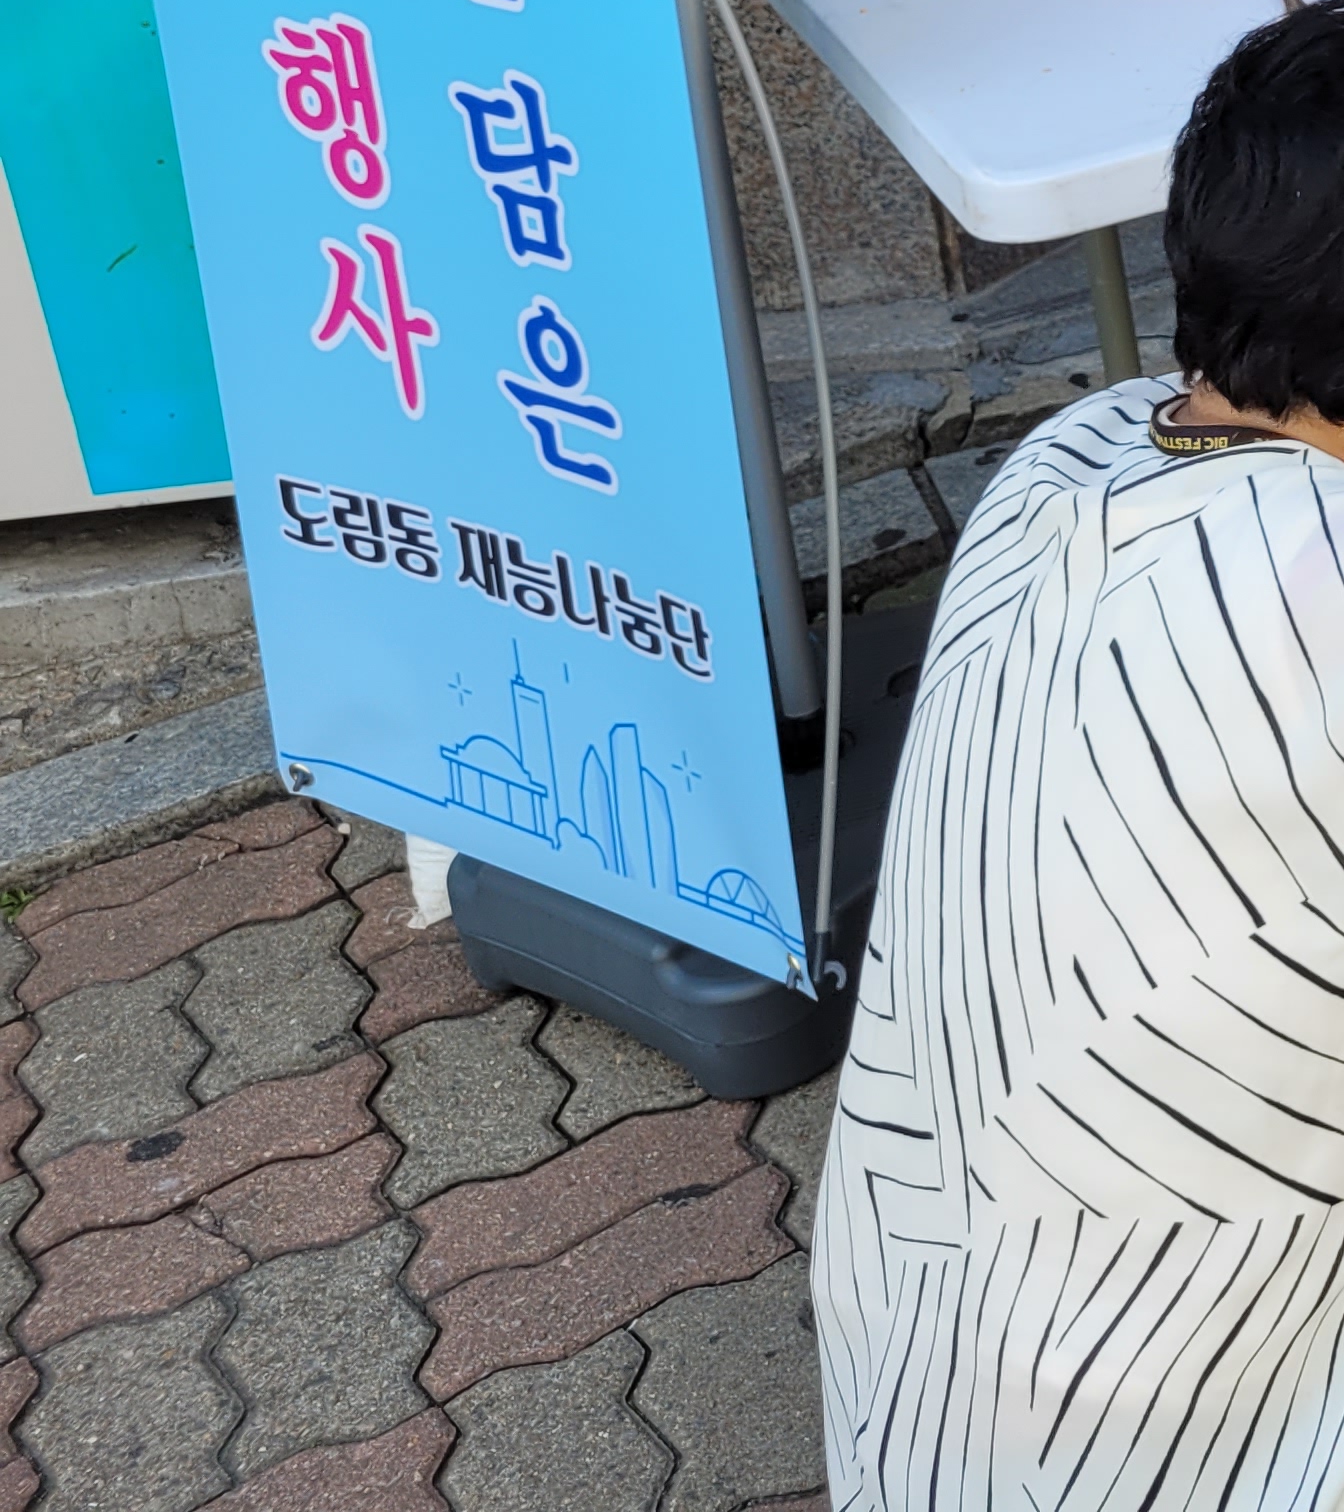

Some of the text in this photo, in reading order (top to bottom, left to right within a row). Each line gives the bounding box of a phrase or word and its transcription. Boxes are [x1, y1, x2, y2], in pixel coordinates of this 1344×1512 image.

[269, 23, 433, 411] 행사
[456, 79, 616, 486] 담은
[278, 478, 712, 678] 도림동 재능나눔단
